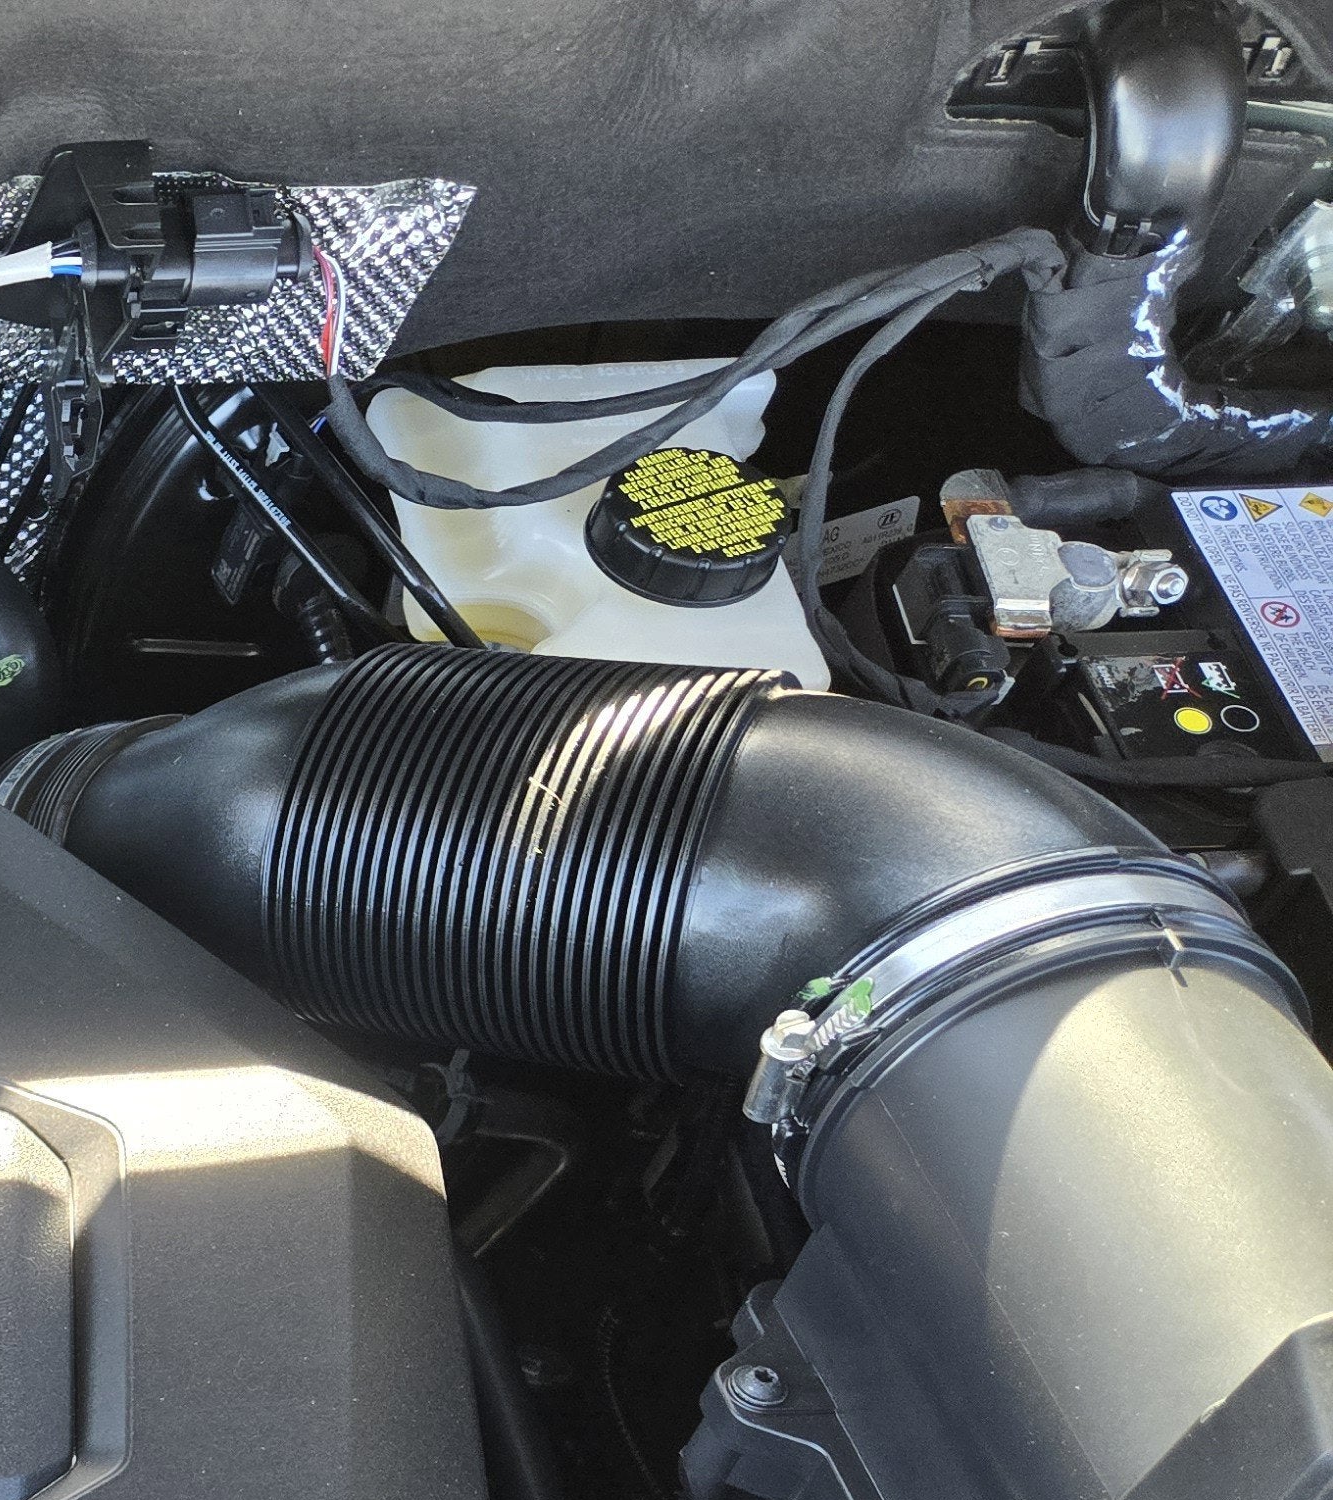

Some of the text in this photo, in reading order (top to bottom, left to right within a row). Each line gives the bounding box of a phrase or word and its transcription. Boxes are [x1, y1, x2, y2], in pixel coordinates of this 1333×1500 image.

[624, 450, 710, 482] CLEAN FILLER CAP
[636, 448, 686, 467] WARNING:
[618, 476, 660, 494] BEFORE
[710, 455, 733, 468] USE
[628, 488, 655, 503] ONLY
[654, 482, 676, 495] DOT
[681, 472, 713, 487] FLUID
[709, 464, 740, 479] FROM
[639, 475, 744, 511] A SEALED CONTAINER.
[1178, 497, 1192, 507] DO
[746, 502, 771, 516] QUE
[766, 498, 785, 510] DU
[1183, 507, 1202, 522] NOT
[648, 512, 698, 533] BOUCHON
[696, 503, 729, 520] AVANT
[715, 523, 776, 547] CONTENANT
[1238, 524, 1257, 541] READ
[1254, 523, 1269, 534] OR
[1269, 522, 1290, 544] CAUSE
[666, 532, 708, 550] LIQUIDE
[1199, 535, 1211, 546] OR
[1224, 524, 1250, 553] LIRE LES
[1300, 554, 1319, 570] ACID
[1311, 570, 1330, 585] CAN
[1221, 574, 1236, 584] NE
[1227, 583, 1245, 598] PAS
[1295, 590, 1312, 604] DES
[1259, 641, 1274, 652] NE
[1274, 632, 1289, 643] OF
[1286, 631, 1318, 671] THE REACH
[1302, 631, 1321, 650] KEEP
[1312, 650, 1331, 667] OUT
[1266, 651, 1284, 667] PAS
[1274, 667, 1301, 695] OUVRIR
[1291, 695, 1305, 706] LA
[1303, 685, 1321, 699] DES
